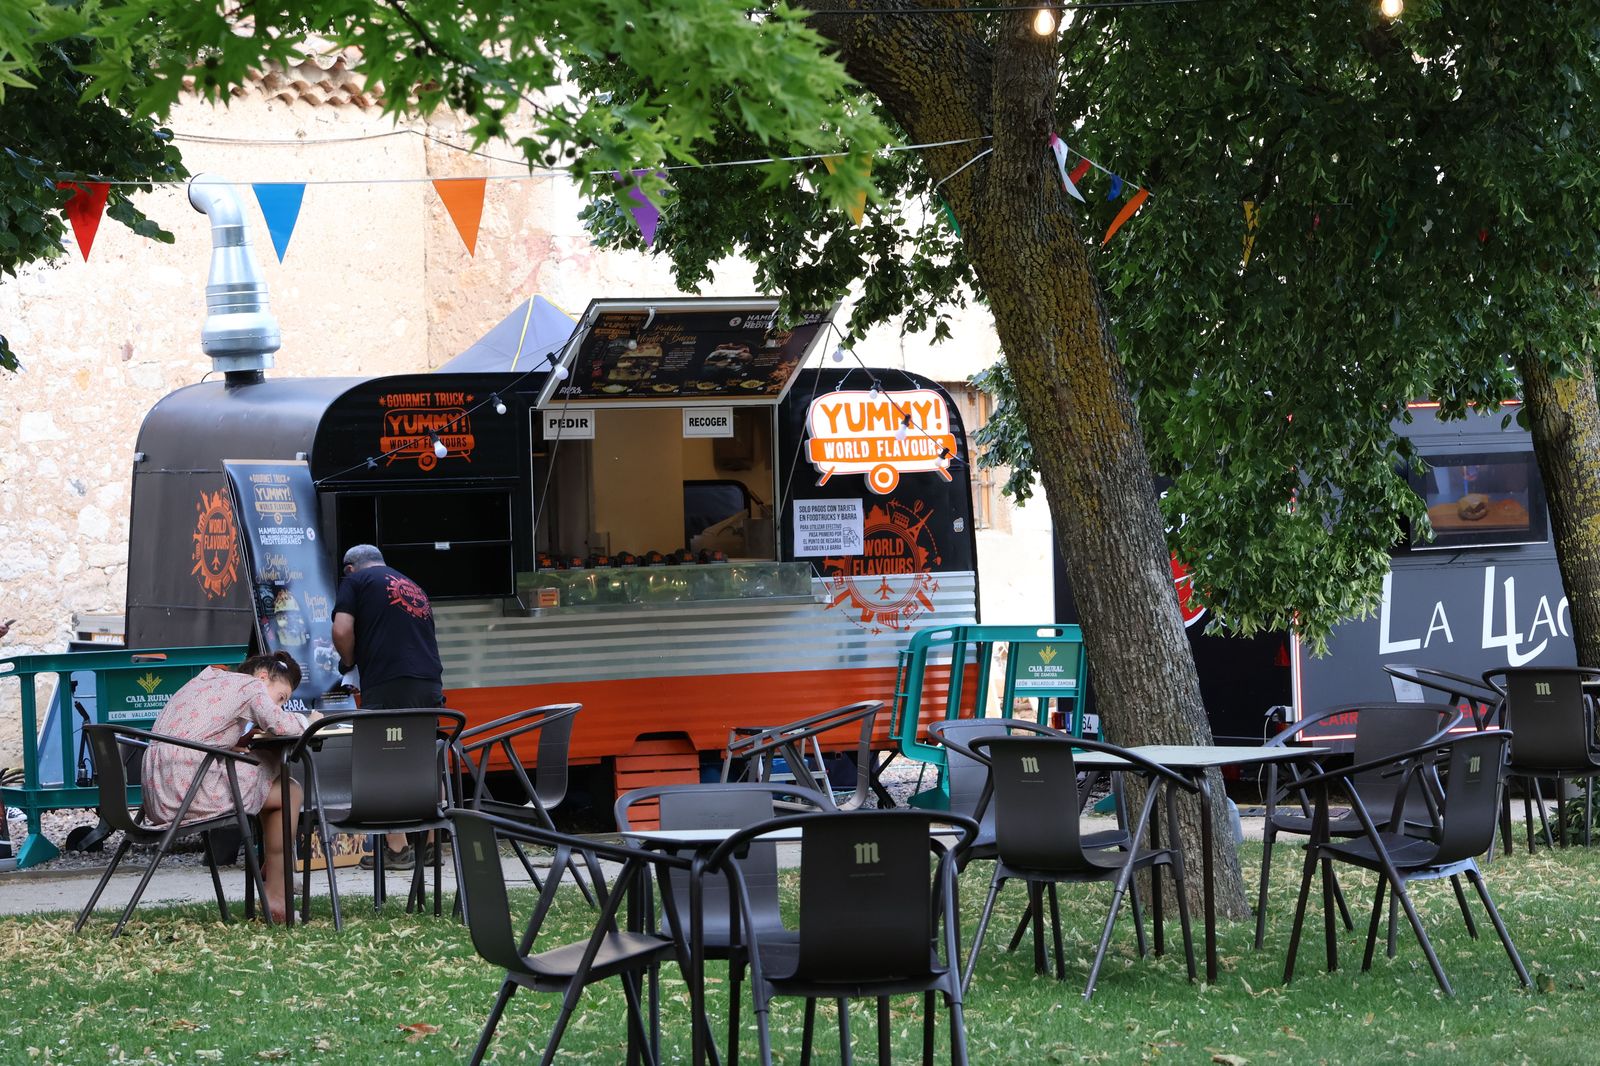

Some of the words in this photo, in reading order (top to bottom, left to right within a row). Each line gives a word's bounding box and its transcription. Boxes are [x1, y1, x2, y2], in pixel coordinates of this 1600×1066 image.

[387, 393, 431, 407] GOURMET
[434, 392, 465, 405] TRUCK
[388, 412, 467, 435] YUMMY!
[549, 418, 589, 429] PEDIR
[689, 417, 727, 427] RECOGER
[820, 399, 942, 434] YUMMY!
[390, 438, 419, 449] WORLD
[824, 441, 870, 459] WORLD
[876, 438, 943, 458] FLAVOURS
[256, 487, 291, 501] YUMMY!
[799, 505, 811, 513] SOLO
[812, 505, 827, 513] PAGOS
[827, 504, 837, 512] CON
[838, 504, 857, 512] TARJETA
[807, 513, 836, 521] FOODTRUCKS
[841, 512, 858, 521] BARRA
[208, 519, 227, 533] WORLD
[258, 527, 304, 535] HAMBURGUESAS
[204, 535, 230, 550] FLAVOURS
[864, 538, 904, 556] WORLD
[853, 557, 914, 576] FLAVOURS
[1028, 665, 1043, 673] CAJA
[1044, 665, 1064, 673] RURAL
[126, 695, 146, 703] CAJA
